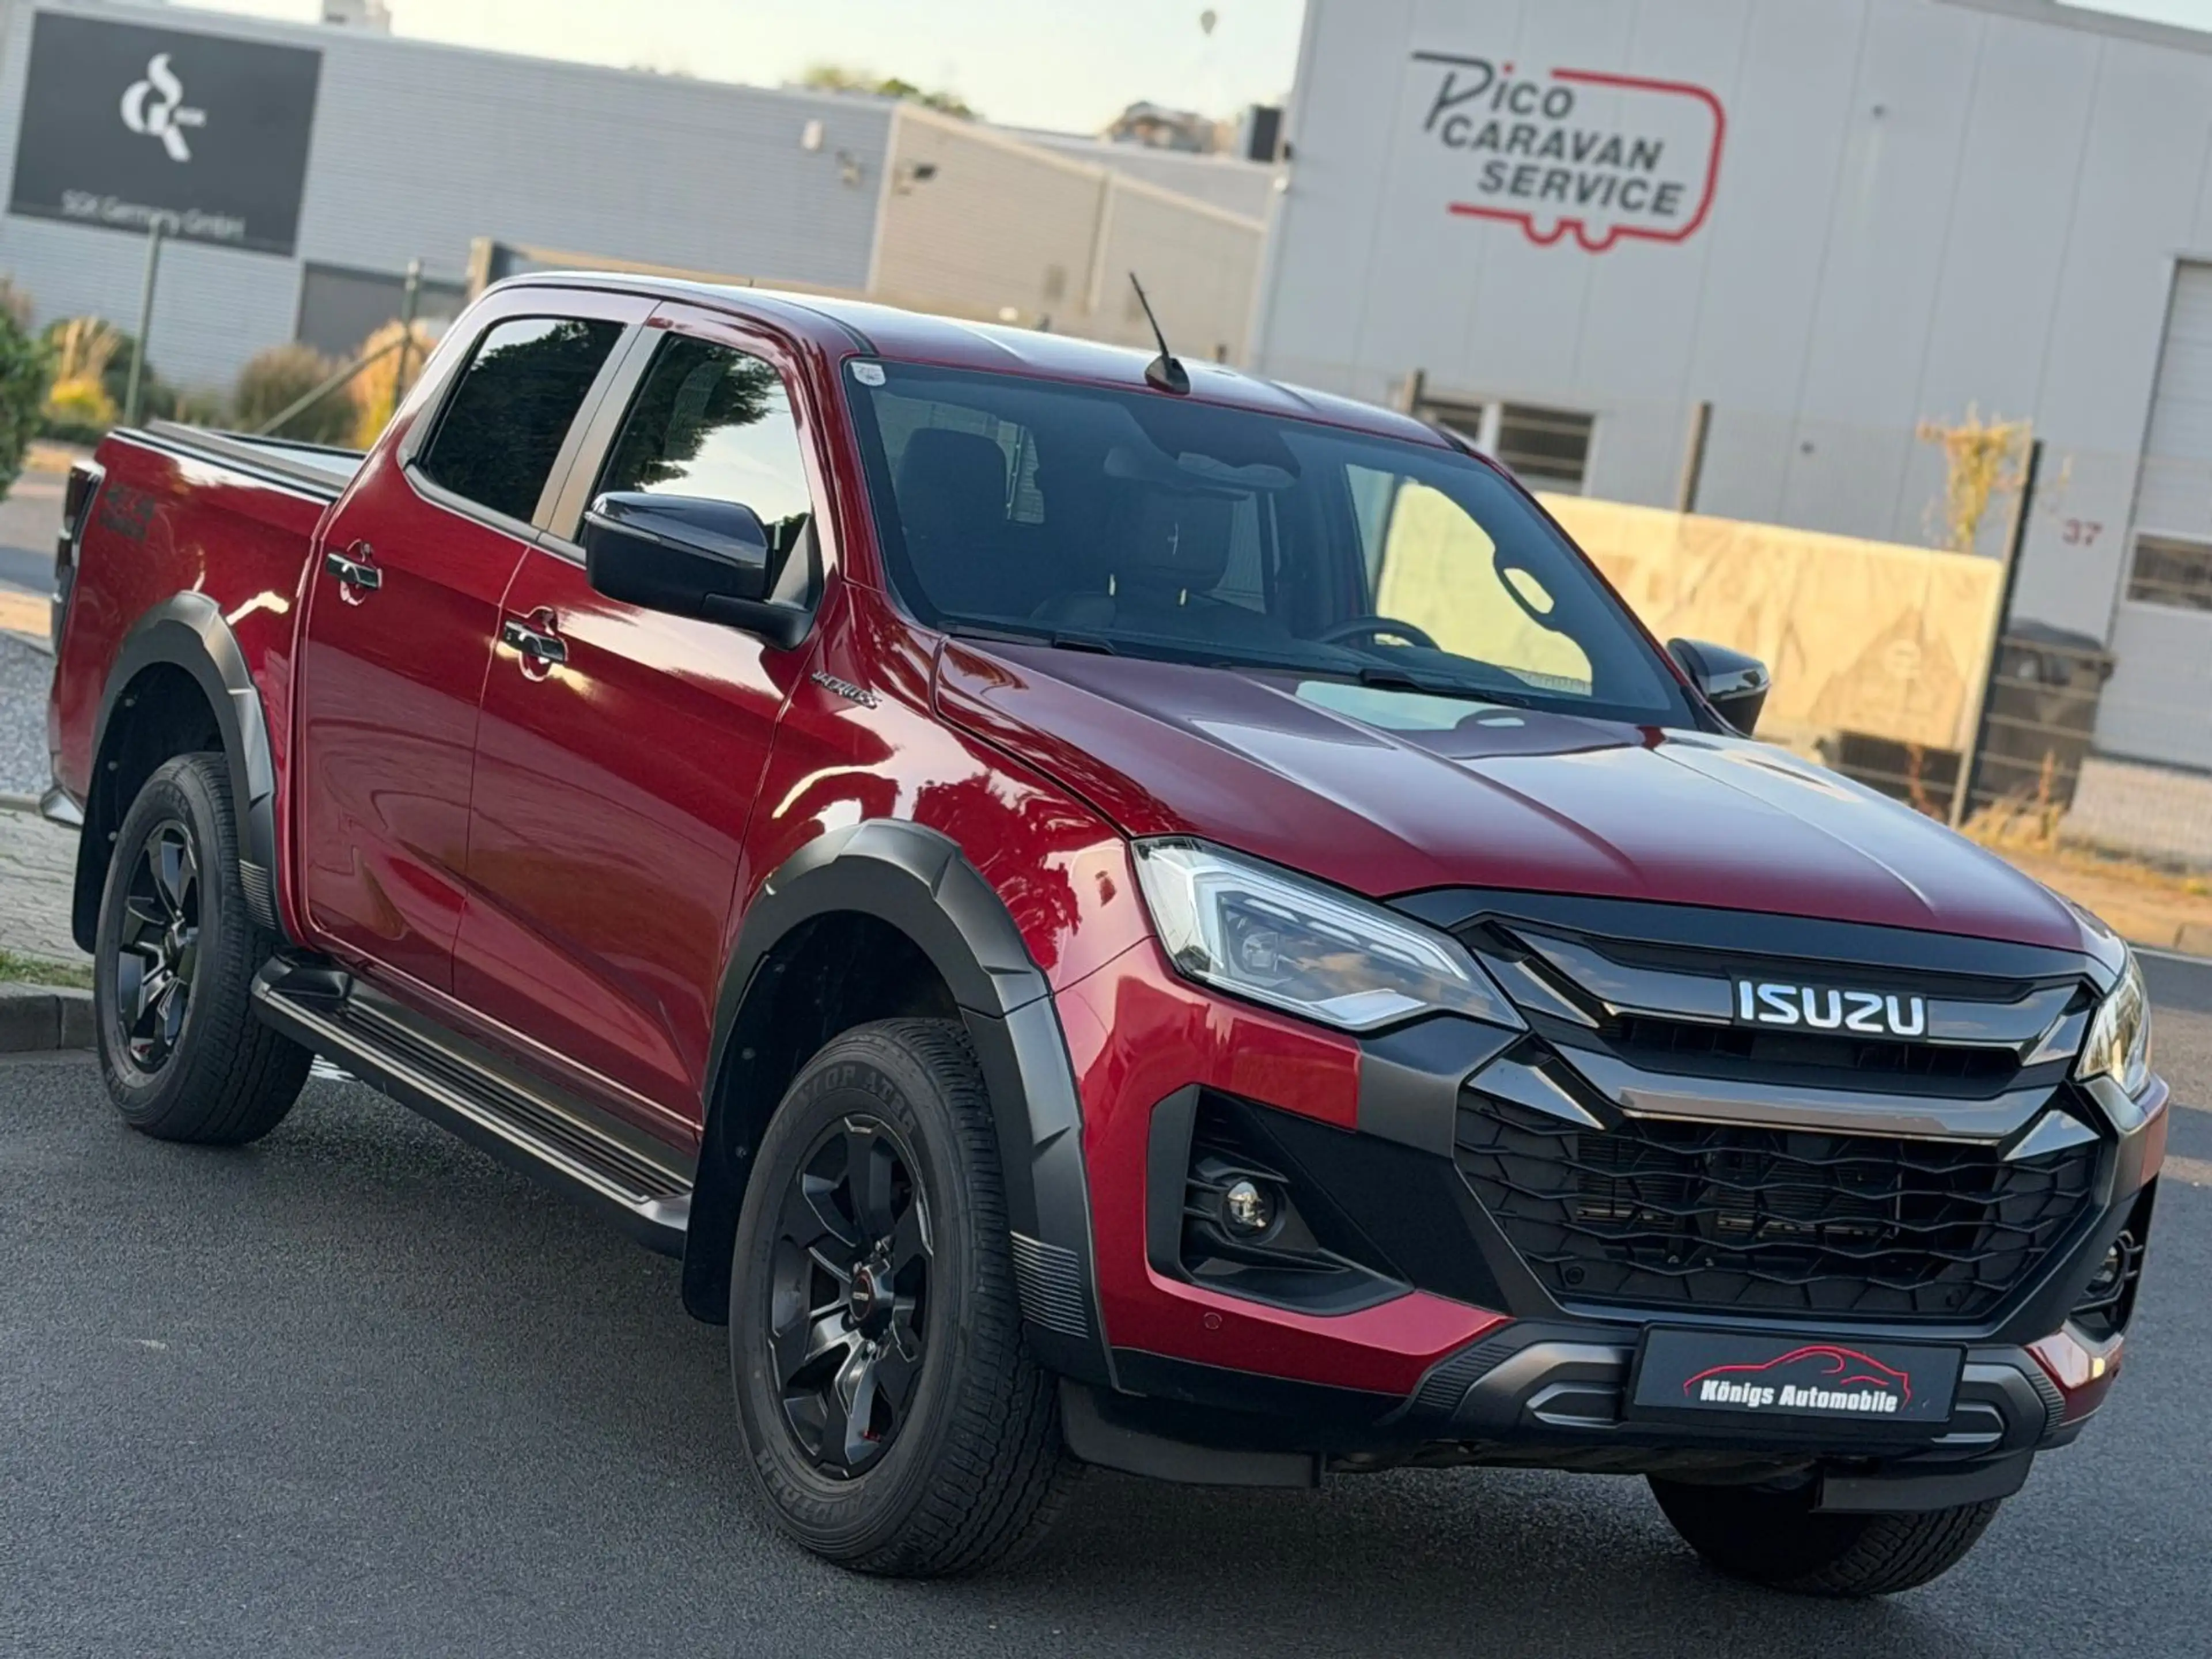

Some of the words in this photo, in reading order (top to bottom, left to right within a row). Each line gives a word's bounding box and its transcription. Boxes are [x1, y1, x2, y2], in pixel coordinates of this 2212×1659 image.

[1441, 115, 1665, 173] CARAVAN
[1477, 160, 1686, 217] SERVICE
[2061, 517, 2103, 547] 37
[1738, 980, 1925, 1035] ISUZU
[1700, 1380, 1774, 1408] Königs
[1778, 1384, 1899, 1413] Automobile
